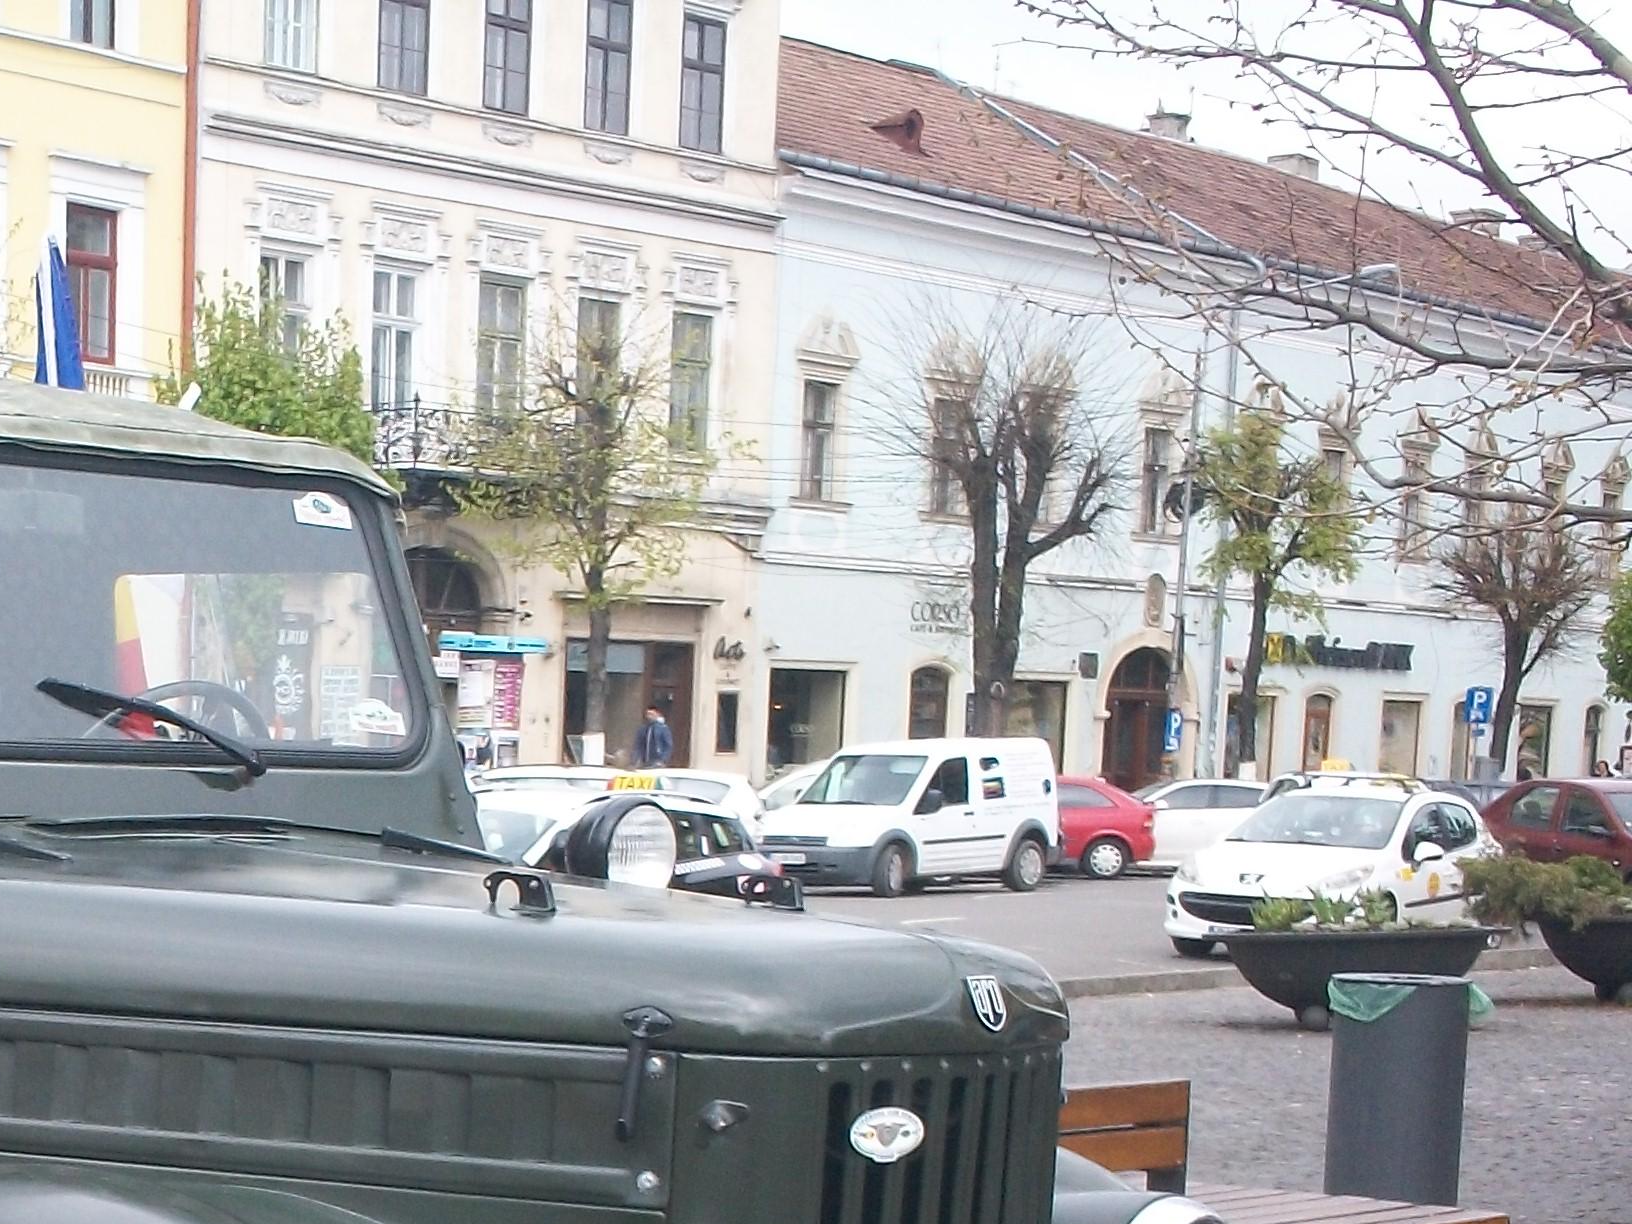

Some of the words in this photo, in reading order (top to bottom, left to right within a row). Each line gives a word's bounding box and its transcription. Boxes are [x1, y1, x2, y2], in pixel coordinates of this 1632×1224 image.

[911, 601, 960, 624] CORSO
[1473, 691, 1487, 709] P
[1171, 711, 1181, 736] P
[617, 776, 655, 789] TAXI
